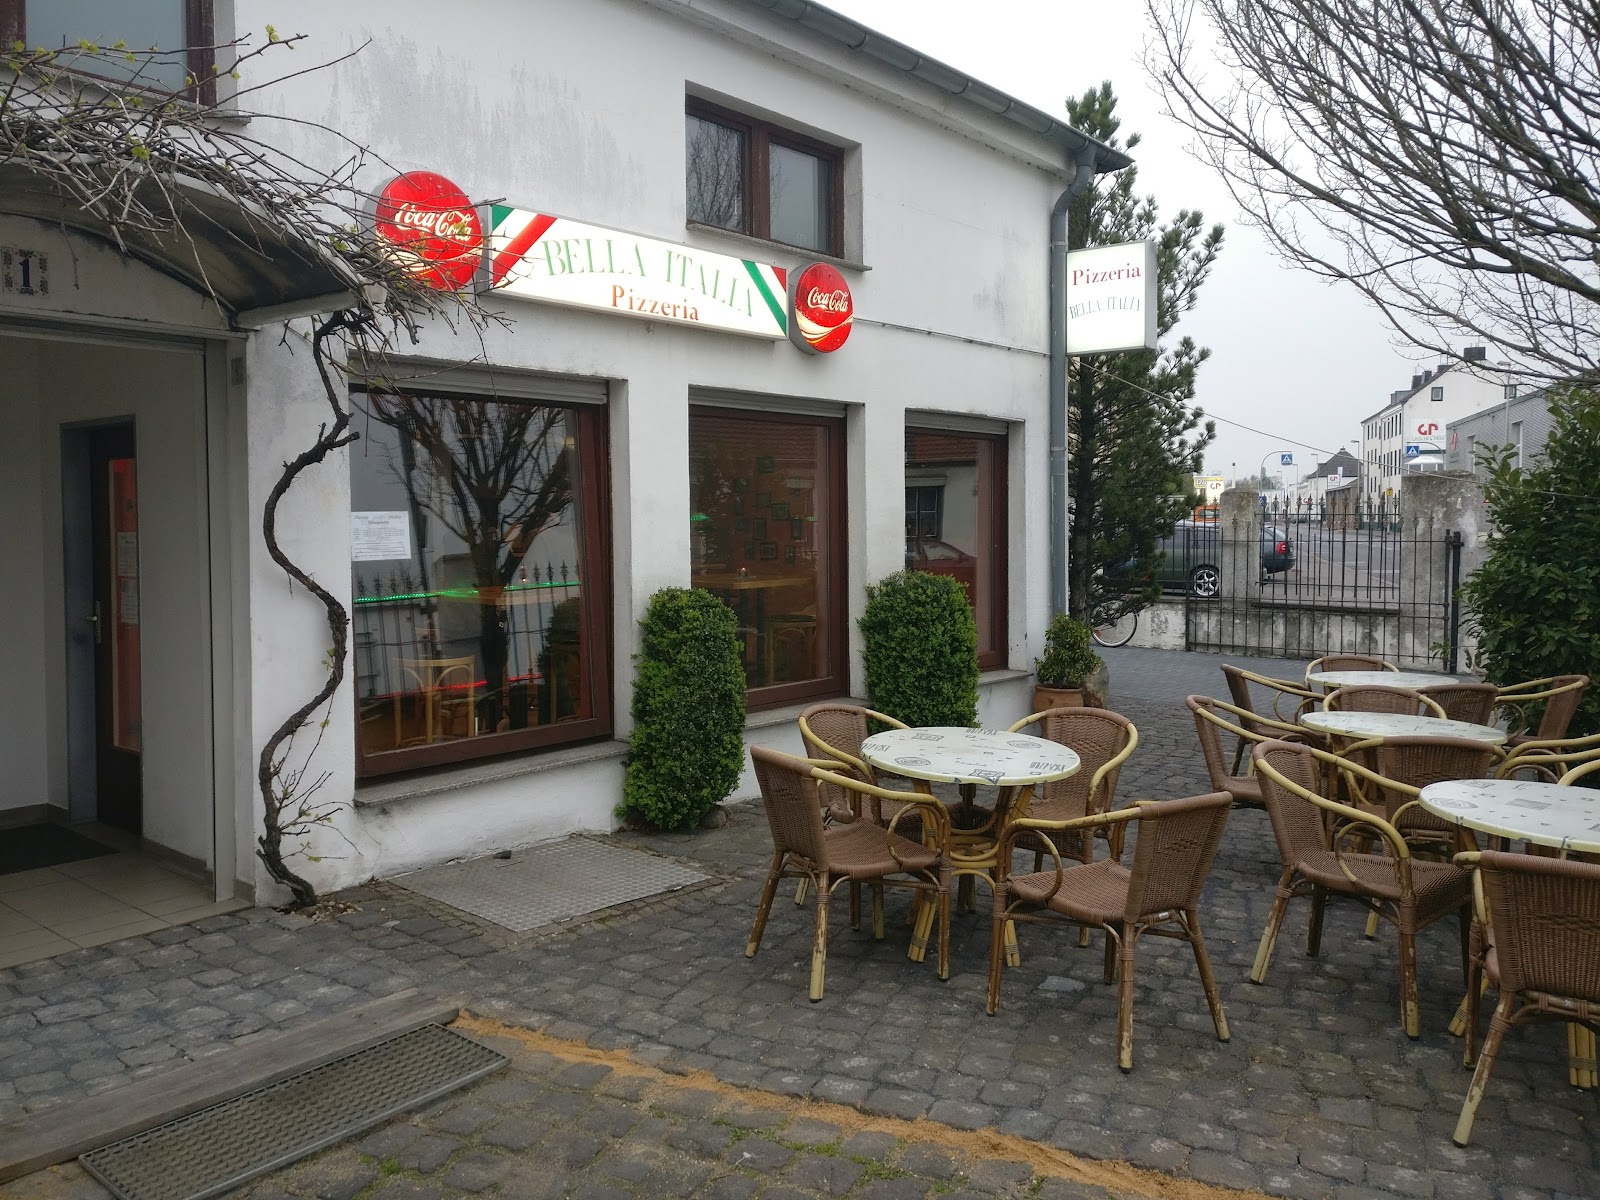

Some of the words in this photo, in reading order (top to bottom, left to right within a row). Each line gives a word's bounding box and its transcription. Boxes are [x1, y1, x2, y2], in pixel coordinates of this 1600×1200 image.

[19, 258, 31, 288] 1
[542, 238, 647, 277] BELLA
[666, 249, 753, 317] ITALIA
[1072, 262, 1141, 286] Pizzeria
[611, 284, 699, 321] Pizzeria
[807, 287, 849, 312] Coca-Cola
[1069, 300, 1101, 319] BELLA
[1107, 296, 1140, 312] ITALIA
